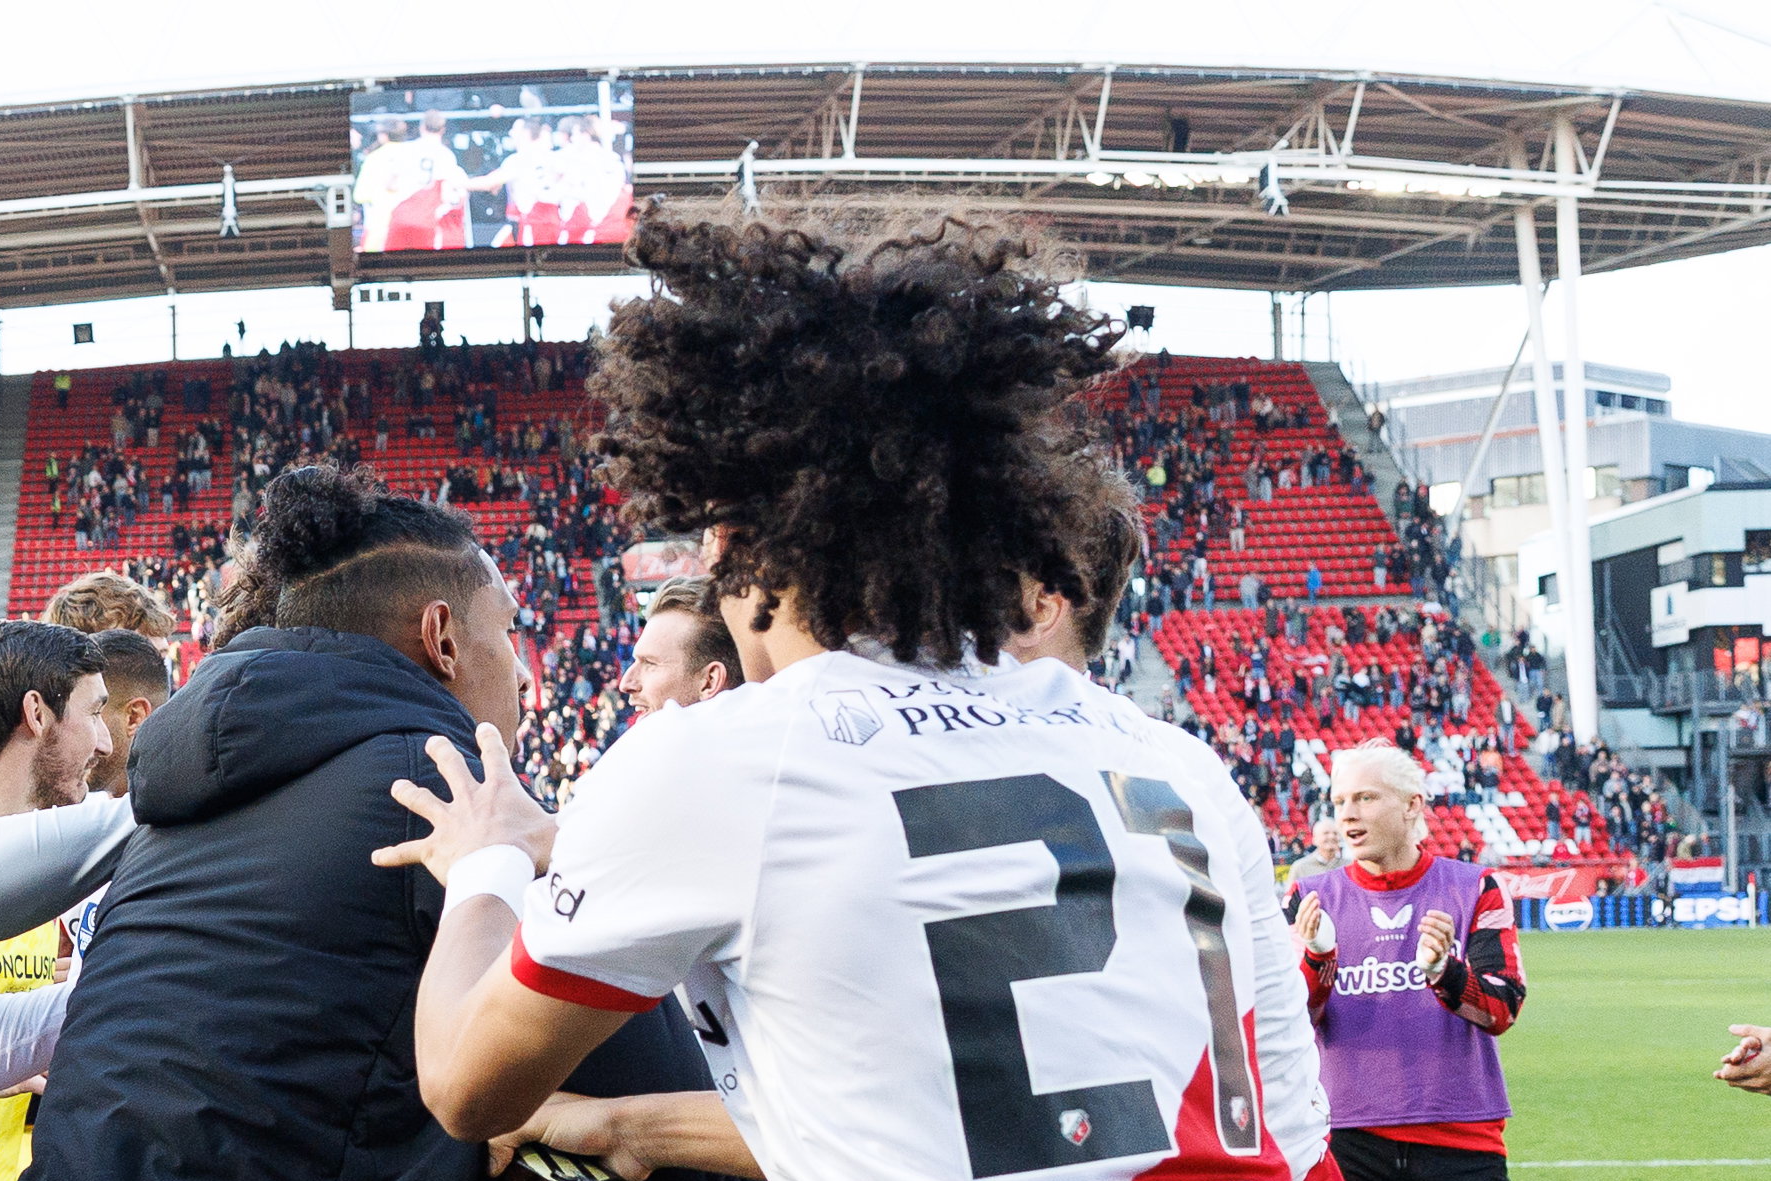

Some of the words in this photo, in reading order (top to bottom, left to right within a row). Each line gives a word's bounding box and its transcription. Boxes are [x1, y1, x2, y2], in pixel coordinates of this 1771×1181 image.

[1652, 897, 1751, 923] EPSI
[890, 769, 1261, 1181] 21
[1335, 957, 1427, 996] wisse
